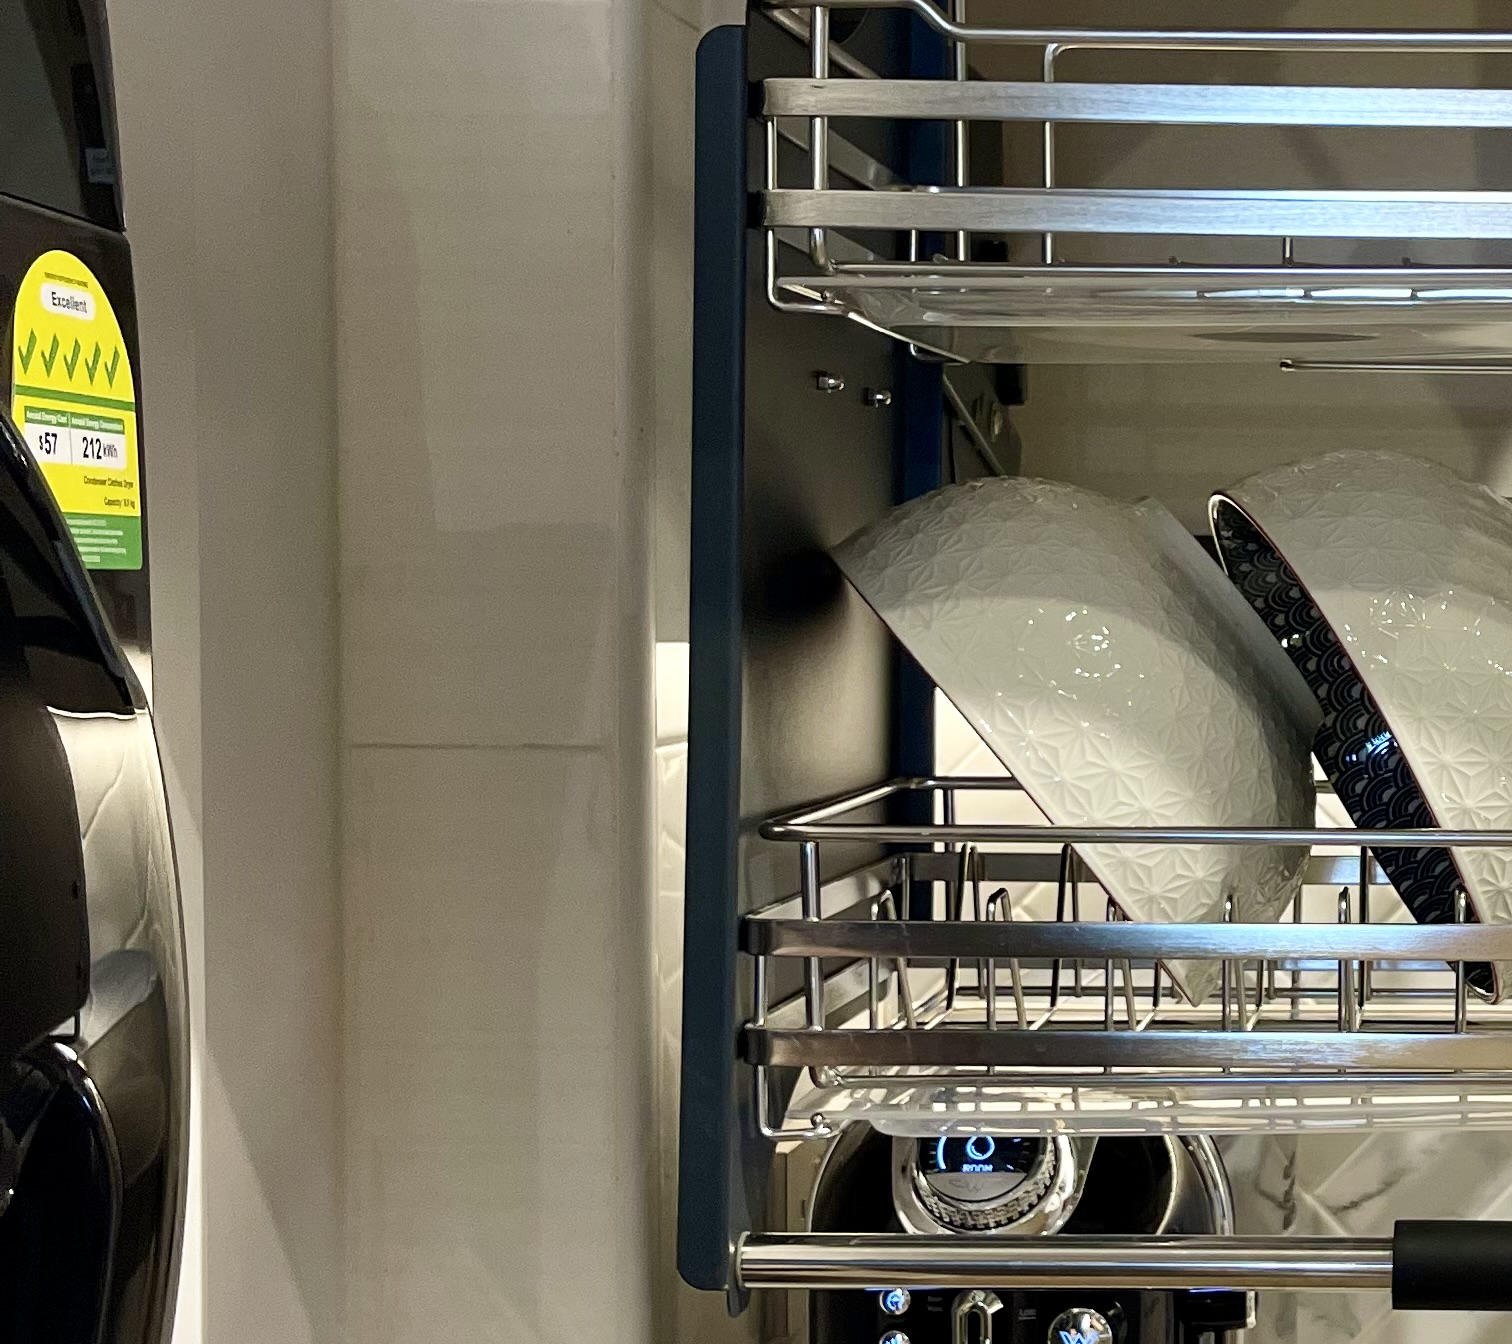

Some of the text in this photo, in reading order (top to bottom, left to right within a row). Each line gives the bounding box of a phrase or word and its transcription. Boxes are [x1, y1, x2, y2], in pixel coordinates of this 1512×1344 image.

[51, 291, 87, 314] Excellent
[39, 432, 58, 455] $57
[82, 436, 102, 460] 212
